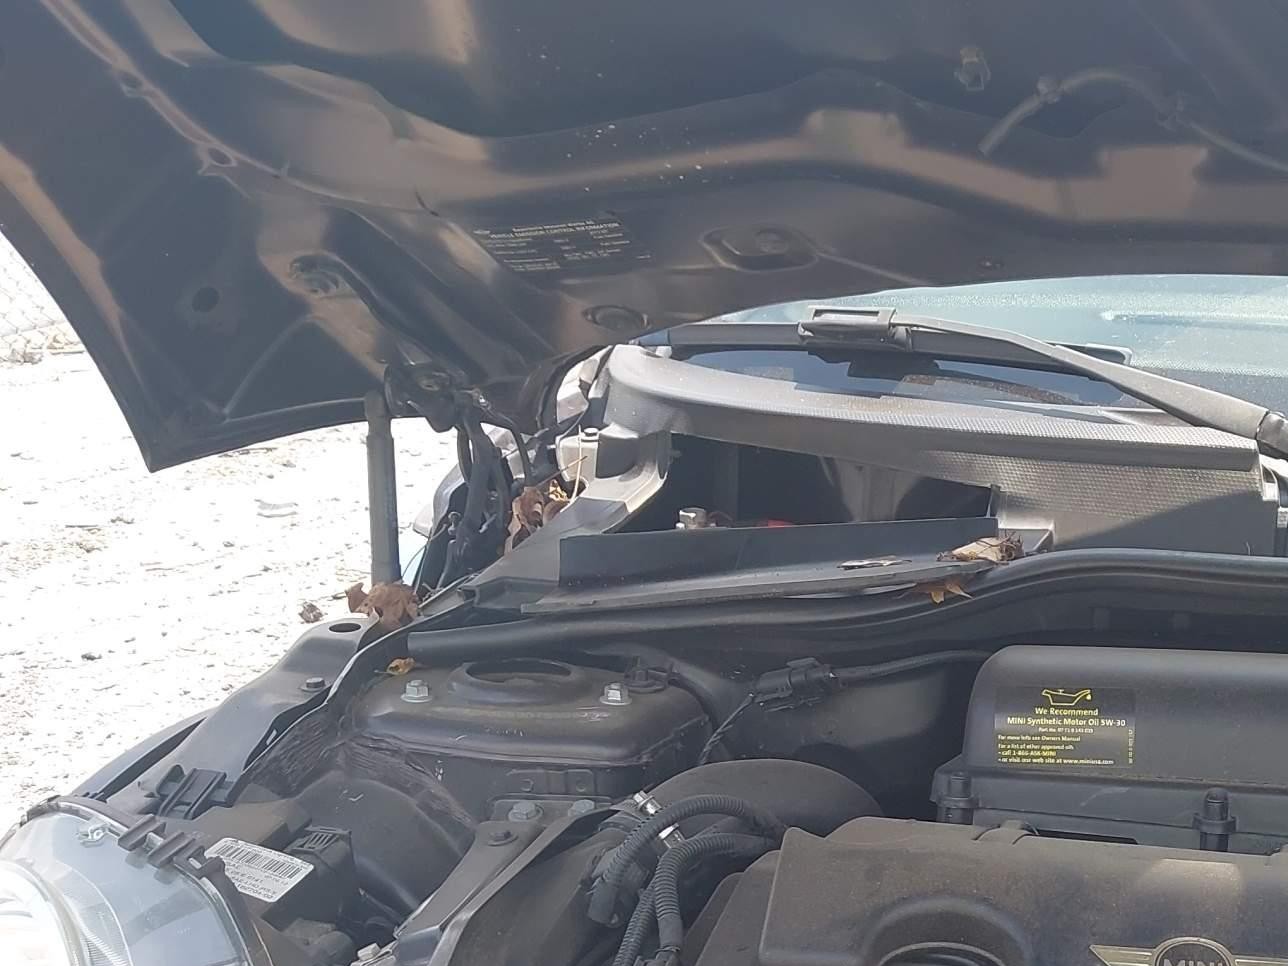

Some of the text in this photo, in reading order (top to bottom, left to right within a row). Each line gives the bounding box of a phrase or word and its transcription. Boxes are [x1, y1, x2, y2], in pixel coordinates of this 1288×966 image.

[1050, 707, 1098, 716] Recommend
[1007, 717, 1126, 727] MINI Synthetic Motor Oil 5W-30
